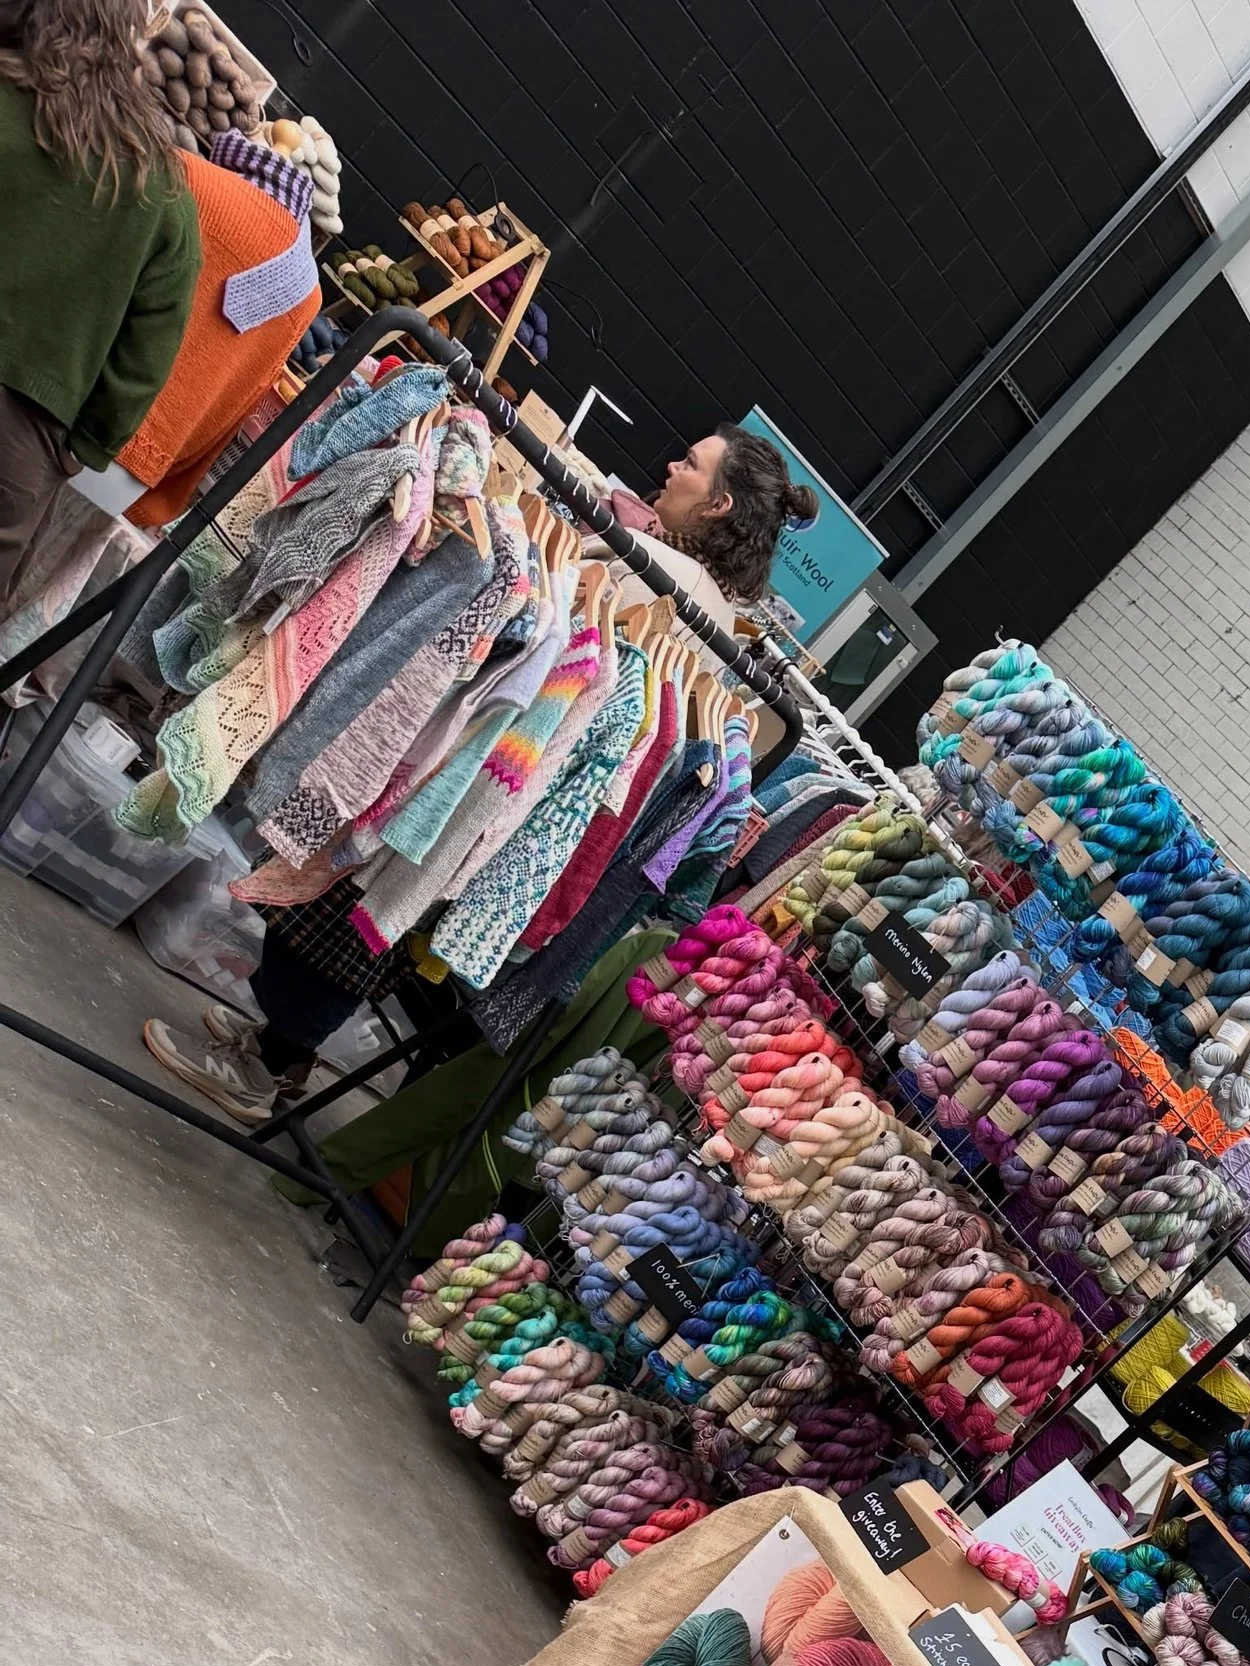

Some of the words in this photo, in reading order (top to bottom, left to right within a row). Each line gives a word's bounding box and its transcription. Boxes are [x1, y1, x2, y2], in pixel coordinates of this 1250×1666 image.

[783, 556, 811, 587] Scotland
[801, 553, 834, 592] Wool
[885, 929, 911, 958] Merino
[651, 1259, 680, 1290] 100%
[675, 1289, 699, 1316] meri
[852, 1510, 903, 1561] giveaway!
[864, 1491, 886, 1516] Enter
[883, 1520, 902, 1542] the
[1043, 1507, 1080, 1553] Giveaway
[934, 1633, 962, 1652] £5
